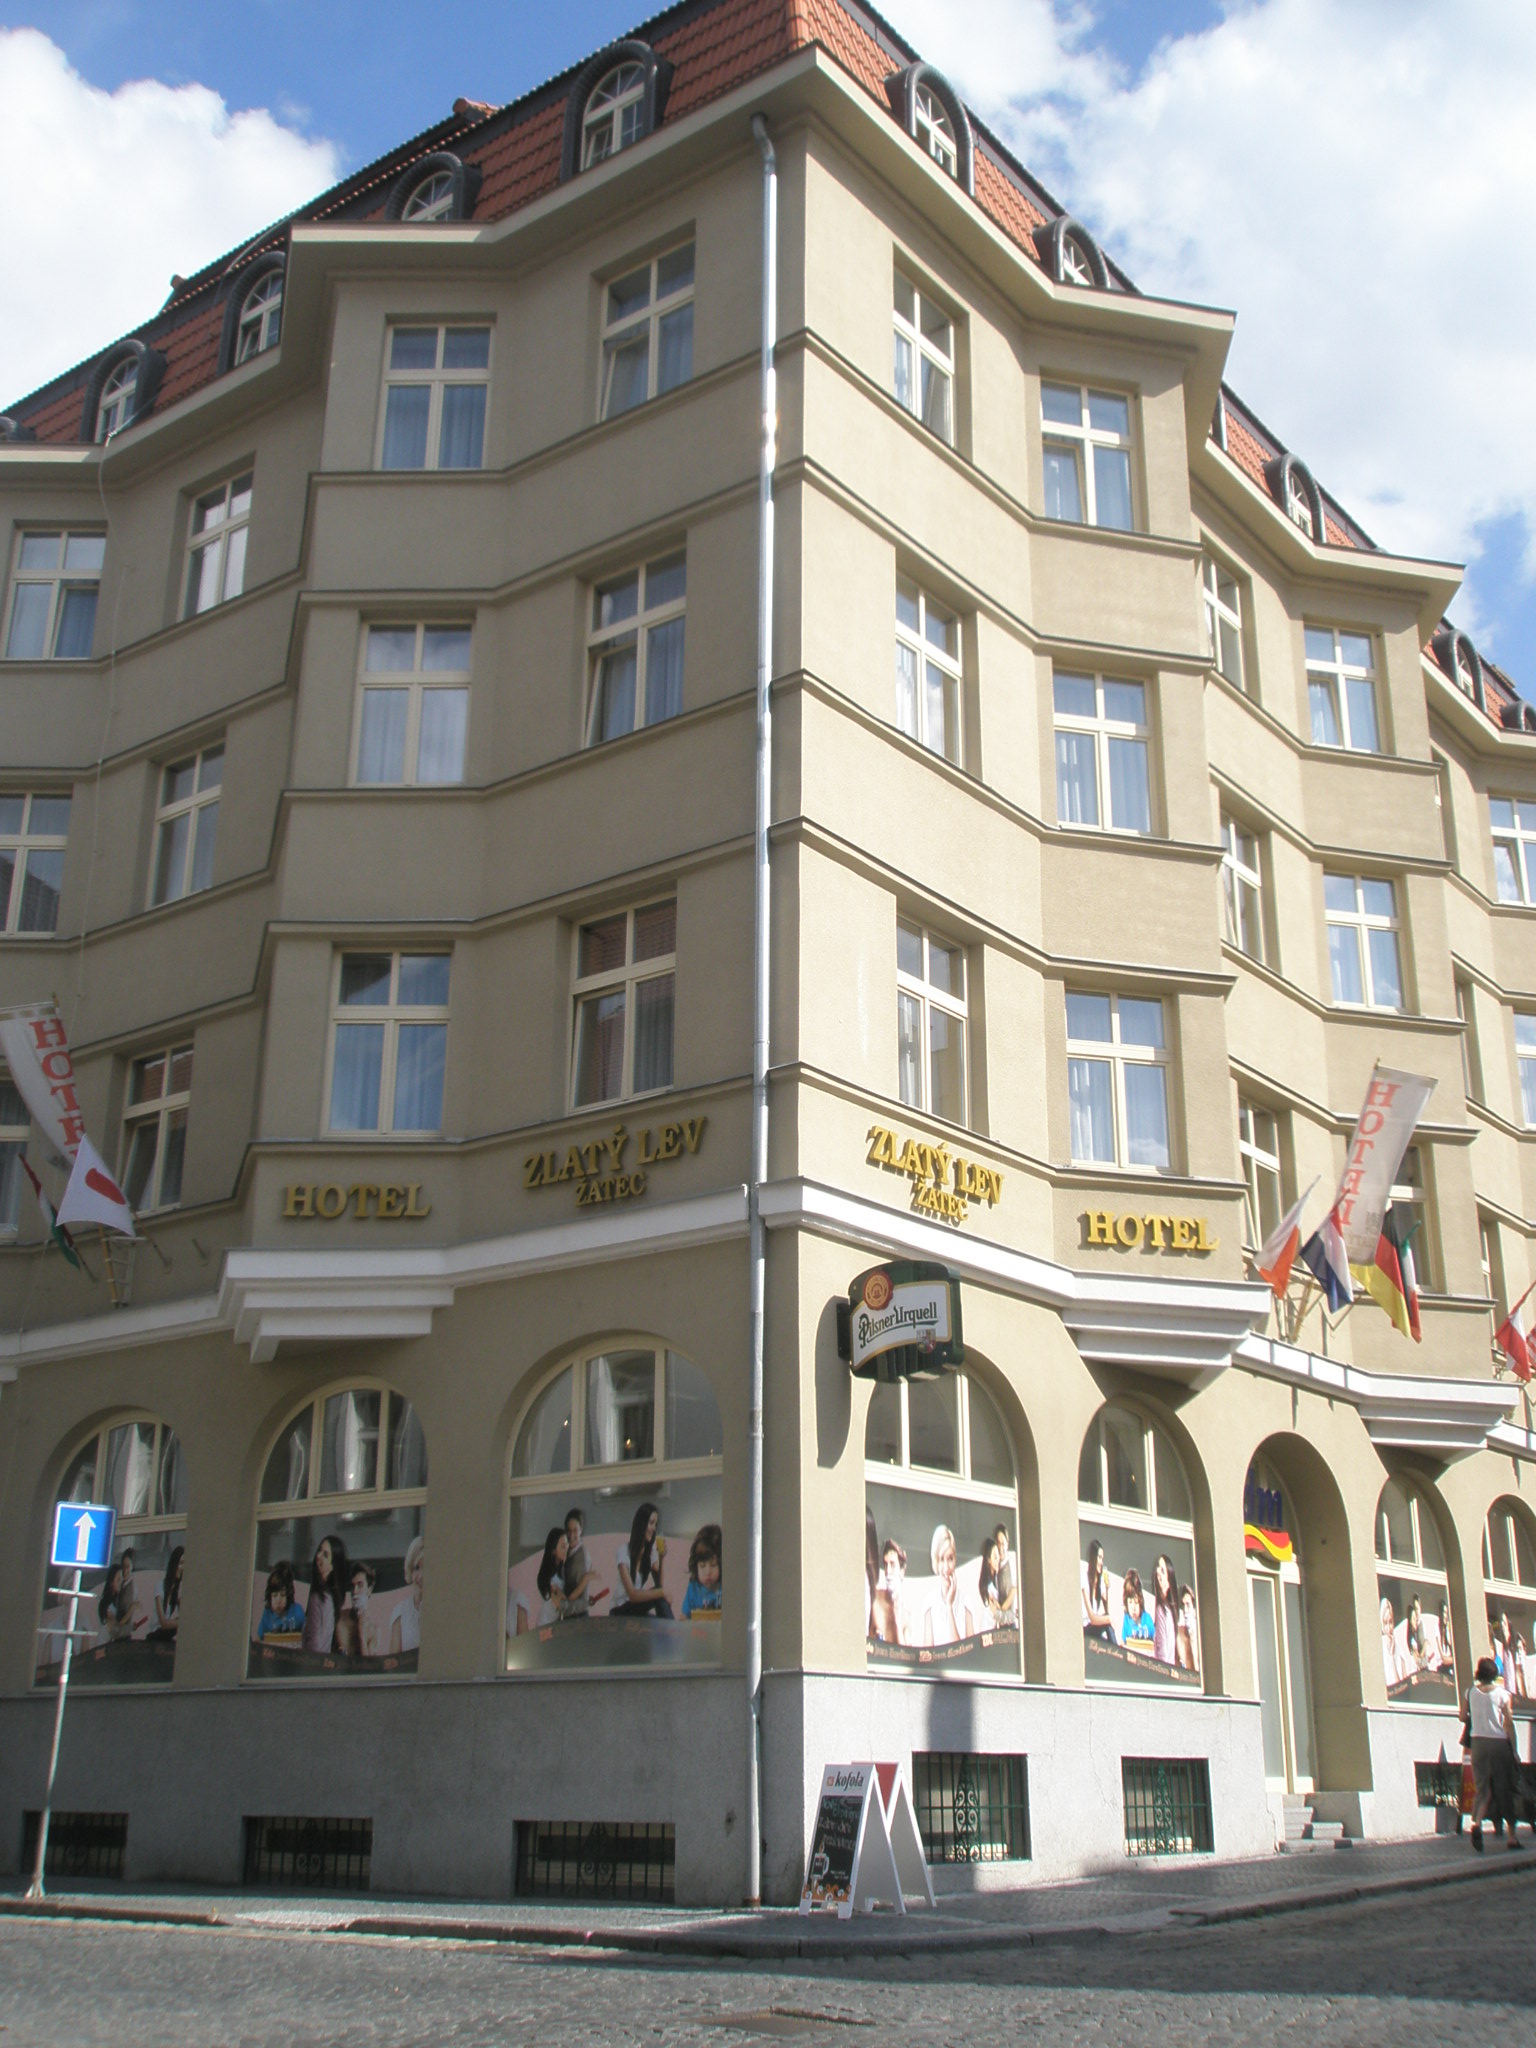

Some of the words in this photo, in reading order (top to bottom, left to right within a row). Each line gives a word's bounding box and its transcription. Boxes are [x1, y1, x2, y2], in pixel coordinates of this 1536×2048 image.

[29, 1018, 87, 1161] HOTE
[523, 1124, 628, 1189] ZLATÝ
[636, 1117, 707, 1166] LEV
[868, 1125, 953, 1185] ZLATÝ
[954, 1157, 1006, 1206] LEV
[283, 1183, 430, 1219] HOTEL
[575, 1171, 647, 1207] ŽATEC
[914, 1180, 969, 1222] ŽATEC
[1086, 1210, 1220, 1251] HOTEL
[858, 1313, 895, 1349] Pilsner
[893, 1302, 938, 1329] Urquell
[835, 1771, 865, 1792] kofola
